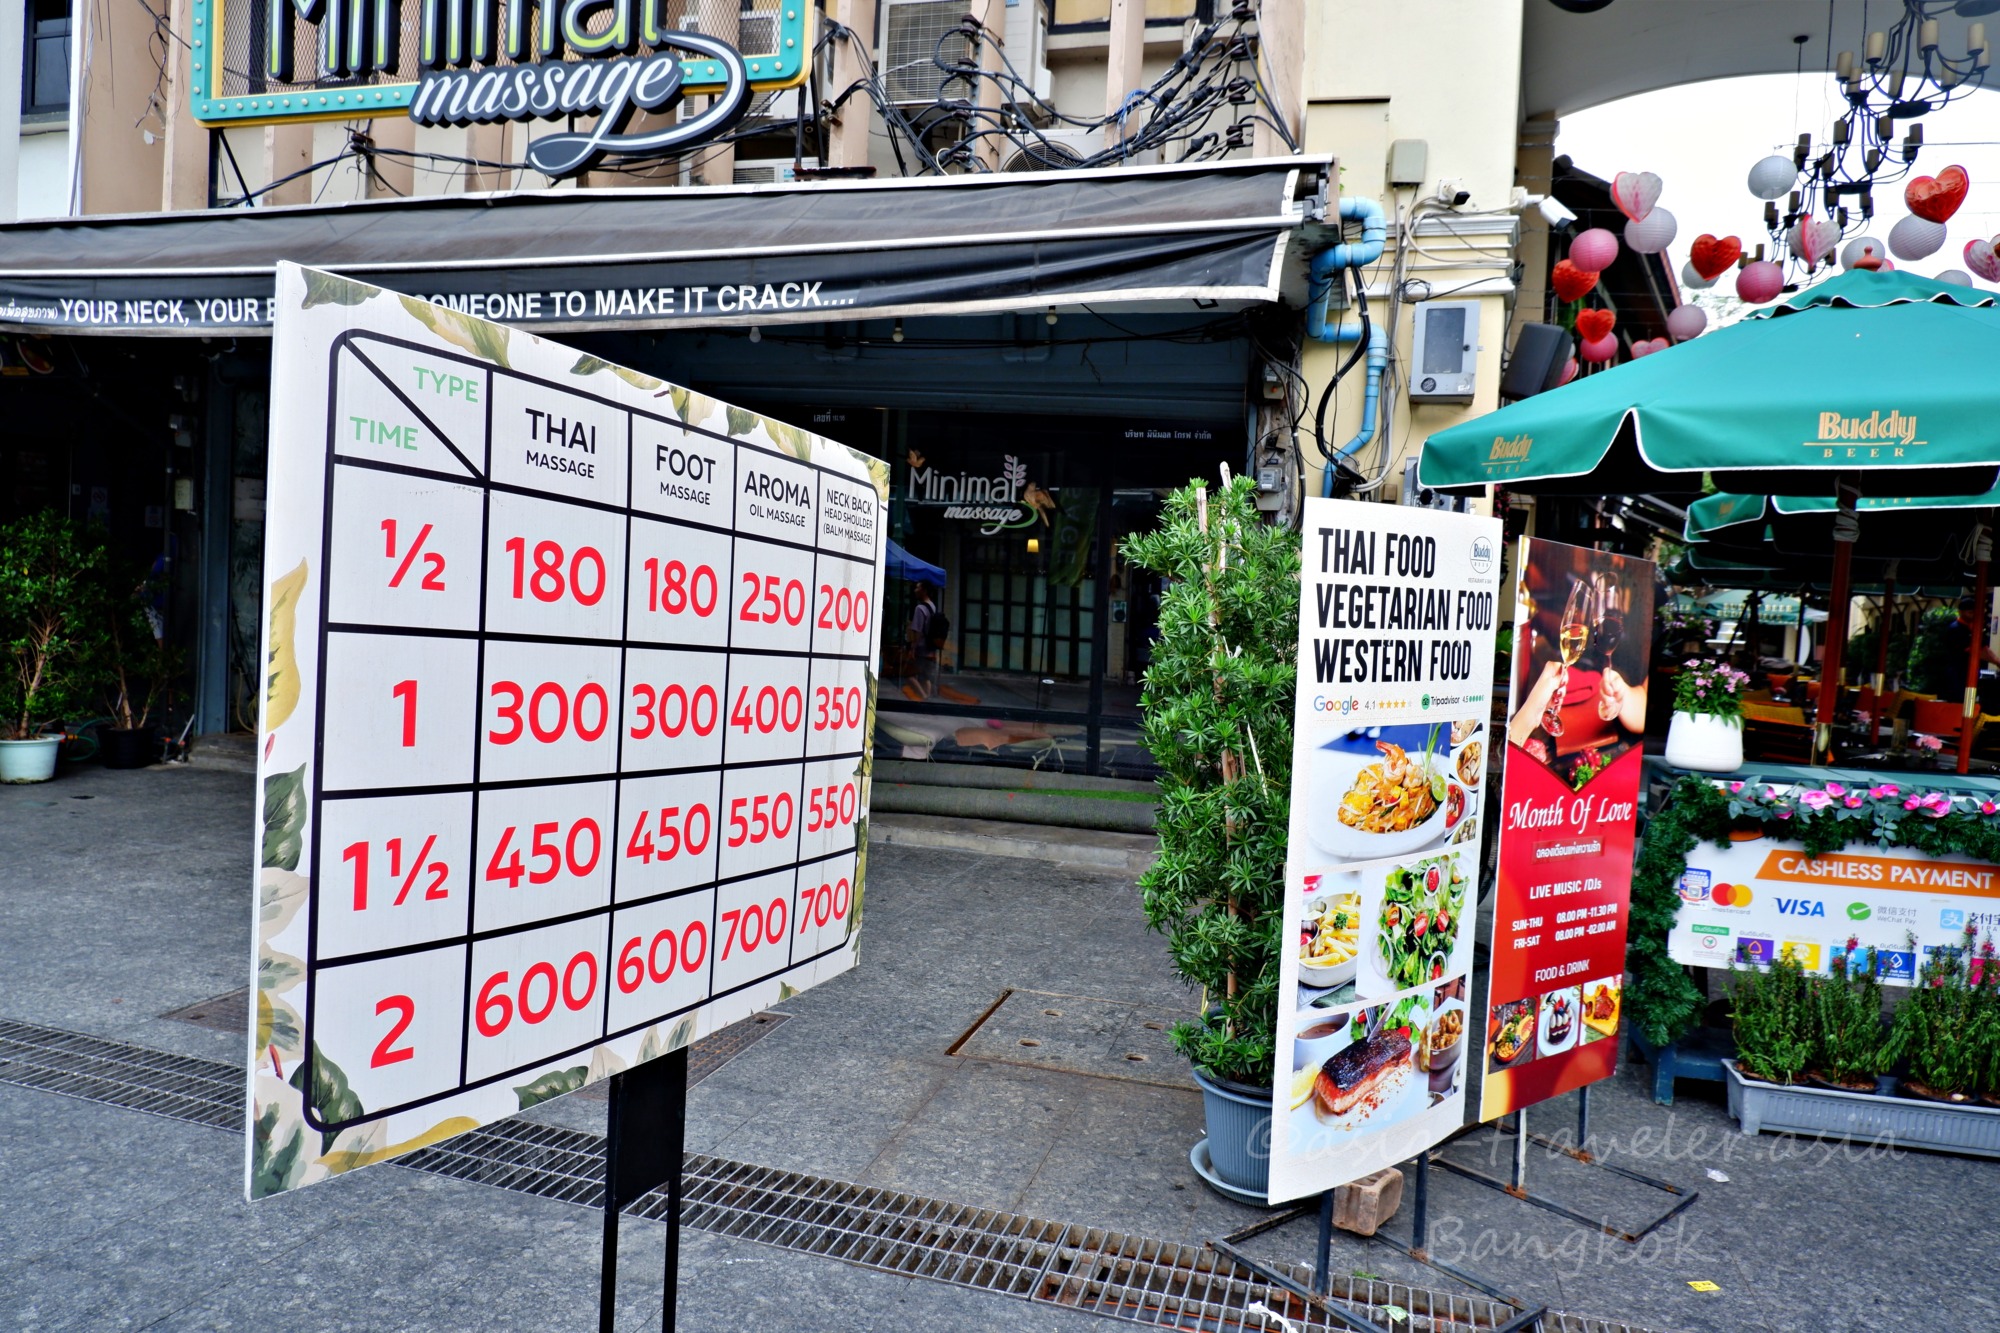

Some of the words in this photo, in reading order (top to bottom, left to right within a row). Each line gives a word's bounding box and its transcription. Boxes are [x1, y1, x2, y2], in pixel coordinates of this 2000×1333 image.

[268, 0, 665, 81] Minima
[411, 52, 690, 175] massage
[60, 298, 118, 323] YOUR
[124, 299, 190, 327] NECK,
[195, 298, 260, 323] YOUR
[550, 291, 586, 317] TO
[595, 288, 674, 316] MAKE
[683, 286, 708, 314] IT
[716, 281, 855, 312] CRACK....
[412, 366, 479, 403] TYPE
[350, 416, 419, 451] TIME
[525, 407, 596, 455] THAI
[1817, 410, 1917, 445] Buddy
[1489, 433, 1533, 462] Buddy
[1823, 447, 1905, 458] BEER
[526, 451, 595, 480] MASSAGE
[656, 444, 716, 485] FOOT
[908, 456, 1020, 503] Minimal
[660, 481, 711, 506] MASSAGE
[744, 470, 811, 510] AROMA
[826, 488, 850, 511] NECK
[851, 498, 873, 516] BACK
[749, 503, 764, 518] OIL
[766, 507, 806, 528] MASSAGE
[824, 507, 842, 522] HEAD
[843, 512, 873, 530] SHOULDER
[943, 505, 1023, 534] massage
[823, 523, 844, 538] (BALM
[844, 527, 873, 546] MASSAGE)
[1318, 527, 1376, 576] THAI
[1385, 532, 1436, 578] FOOD
[506, 537, 605, 607] 180
[645, 558, 717, 618] 180
[740, 573, 804, 626] 250
[818, 585, 868, 633] 200
[1316, 583, 1450, 631] VEGETARIAN
[1456, 590, 1492, 631] FOOD
[1314, 638, 1423, 684] WESTERN
[1430, 639, 1472, 681] FOOD
[393, 680, 418, 747] 1
[490, 681, 608, 746] 300
[630, 684, 718, 739] 300
[730, 686, 803, 735] 400
[814, 687, 861, 731] 350
[1314, 694, 1359, 715] Google
[1365, 700, 1376, 711] 4.1
[1431, 695, 1460, 706] Tripadvisor
[1508, 796, 1565, 830] Month
[1570, 794, 1595, 835] Of
[1596, 797, 1632, 823] Love
[486, 817, 600, 889] 450
[626, 803, 711, 865] 450
[728, 792, 794, 848] 550
[807, 782, 855, 833] 550
[1778, 857, 1883, 881] CASHLESS
[1890, 865, 1994, 890] PAYMENT
[1529, 884, 1552, 900] LIVE
[1553, 879, 1582, 896] MUSIC
[1512, 916, 1543, 931] SUN-THU
[1556, 910, 1576, 924] 08.00
[1576, 908, 1588, 920] PM
[1607, 903, 1618, 915] PM
[1711, 906, 1751, 915] mastercard
[1773, 897, 1825, 917] VISA
[1877, 916, 1903, 924] WeChat
[1904, 917, 1917, 925] Pay
[1513, 935, 1541, 949] FRI-SAT
[1574, 926, 1585, 938] PM
[1606, 920, 1617, 931] AM
[370, 995, 415, 1069] 2
[475, 950, 598, 1038] 600
[617, 921, 707, 994] 600
[721, 898, 788, 962] 700
[801, 878, 850, 934] 700
[1535, 967, 1557, 984] FOOD
[1558, 964, 1566, 977] &
[1566, 958, 1590, 975] DRINK
